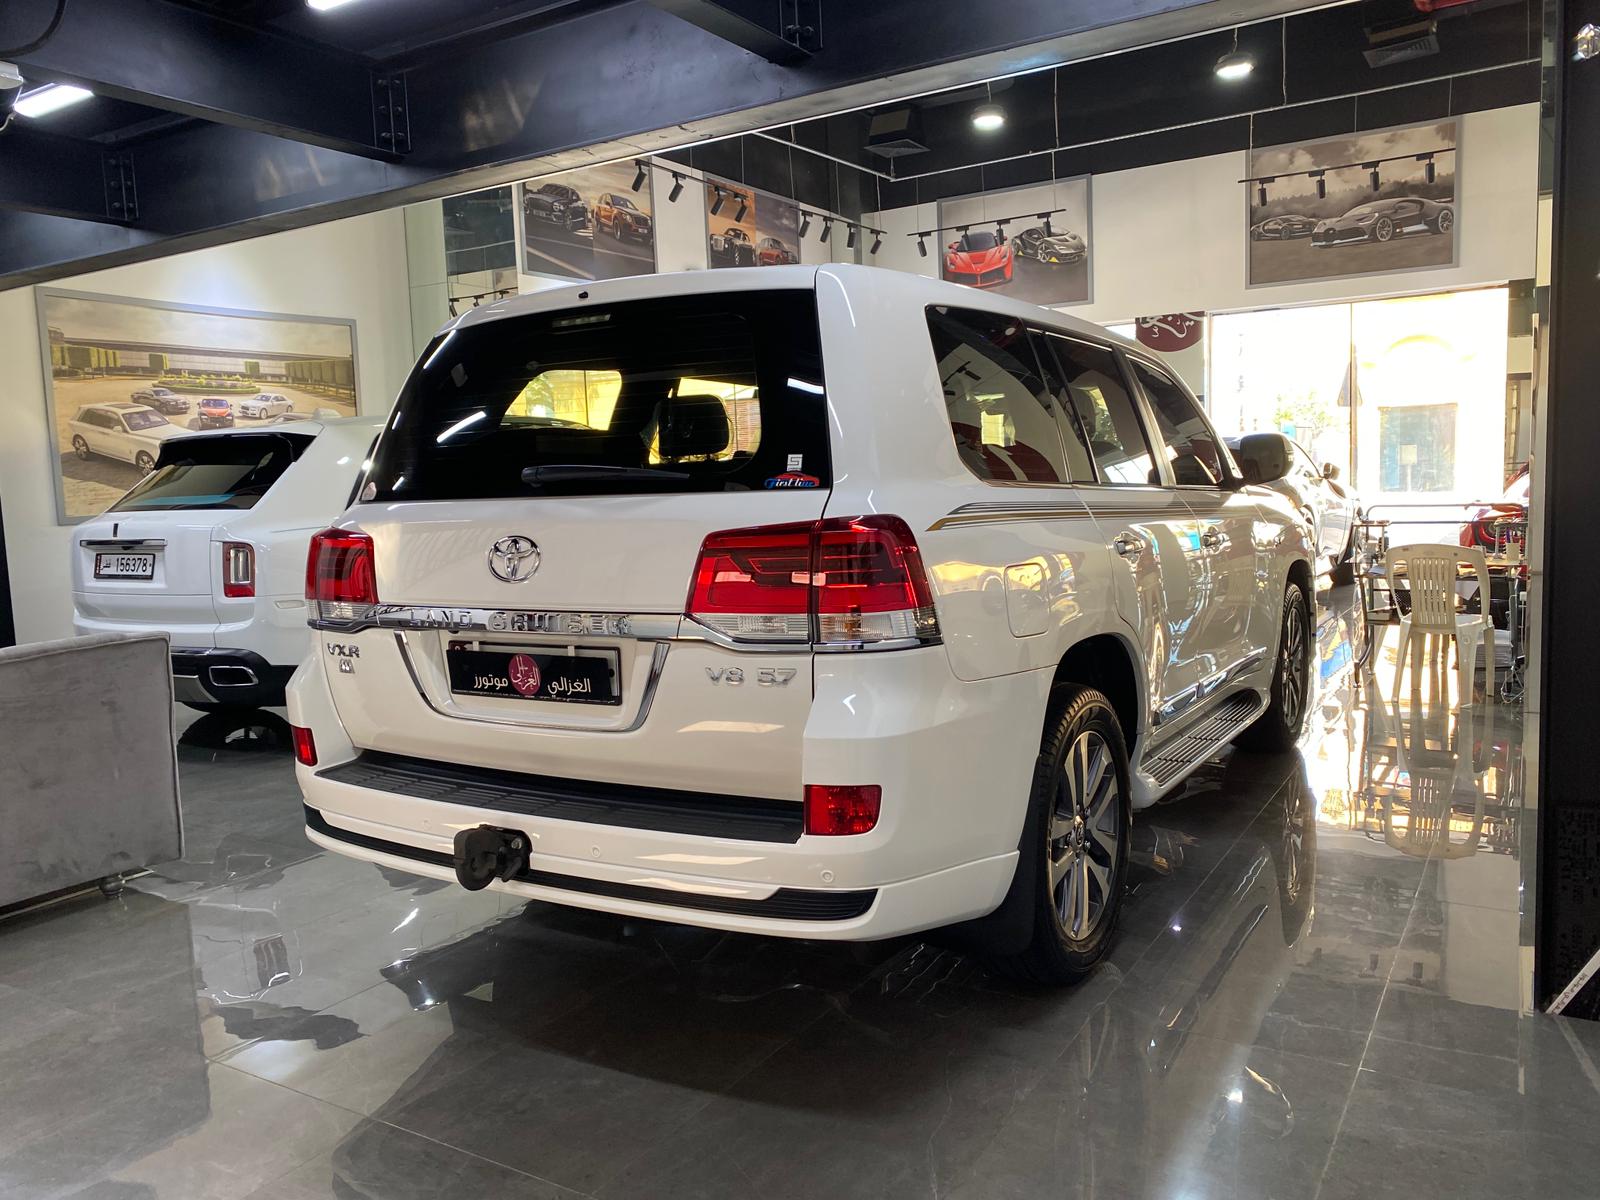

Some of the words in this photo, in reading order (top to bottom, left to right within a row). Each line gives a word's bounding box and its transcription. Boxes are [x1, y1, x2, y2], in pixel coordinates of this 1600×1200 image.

[116, 557, 148, 573] 156378
[409, 608, 472, 629] LAND
[488, 611, 631, 636] CRUISER
[473, 674, 508, 690] موتورز
[704, 666, 744, 686] V8
[547, 676, 591, 697] الغزالي
